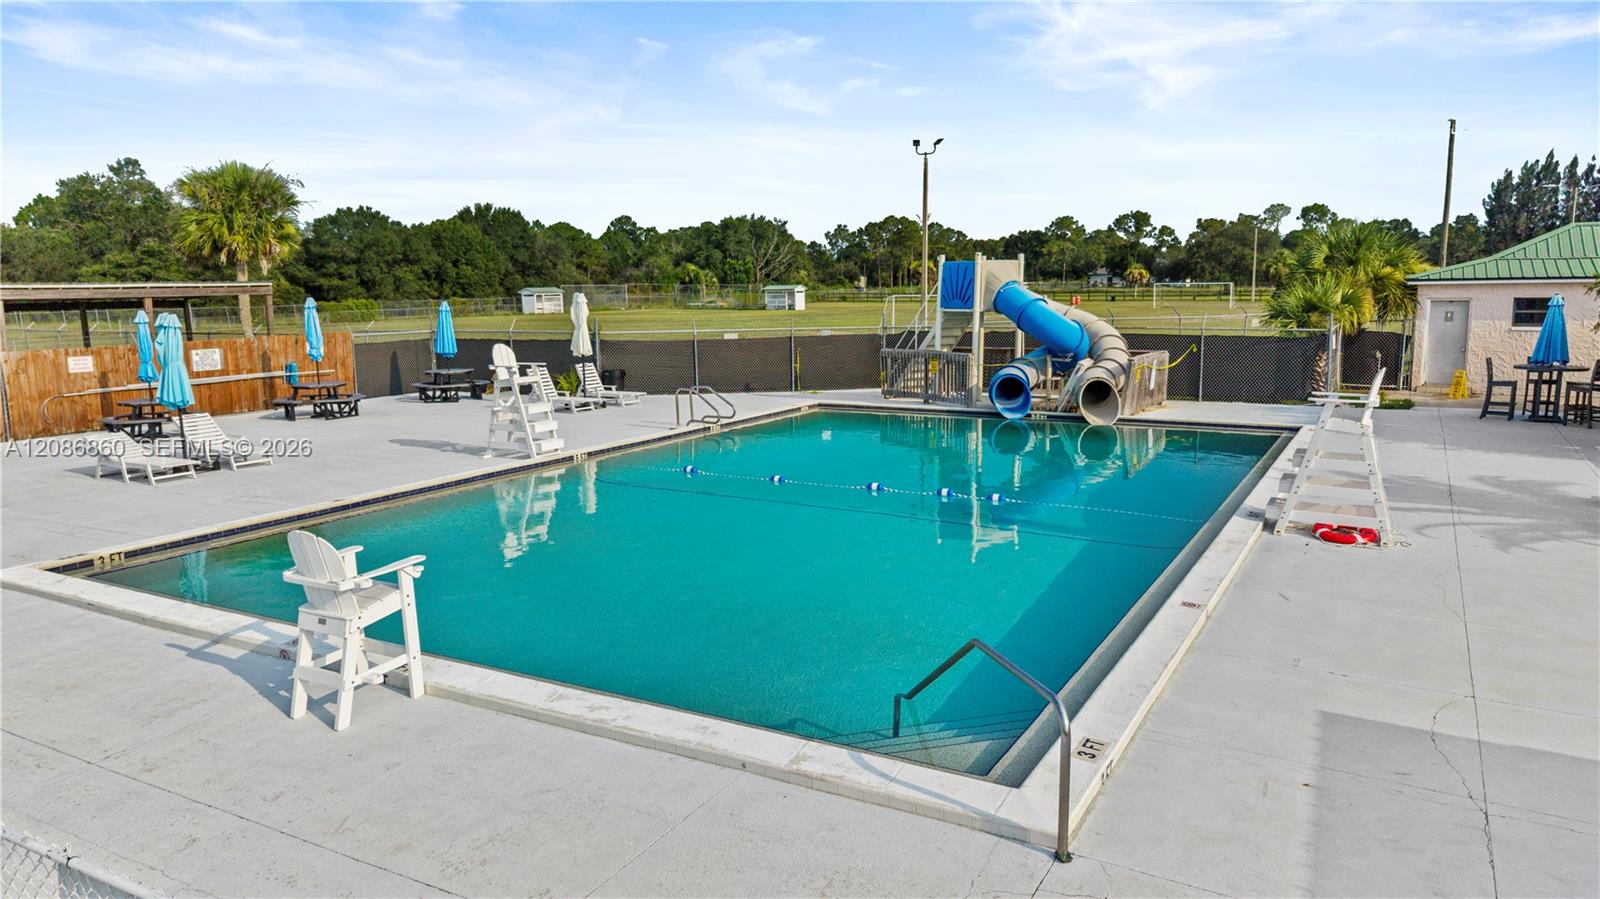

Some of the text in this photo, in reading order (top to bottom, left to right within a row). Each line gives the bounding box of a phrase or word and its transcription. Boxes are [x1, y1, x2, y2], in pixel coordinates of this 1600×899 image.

[109, 551, 123, 564] FT
[1077, 738, 1105, 759] 3 FT
